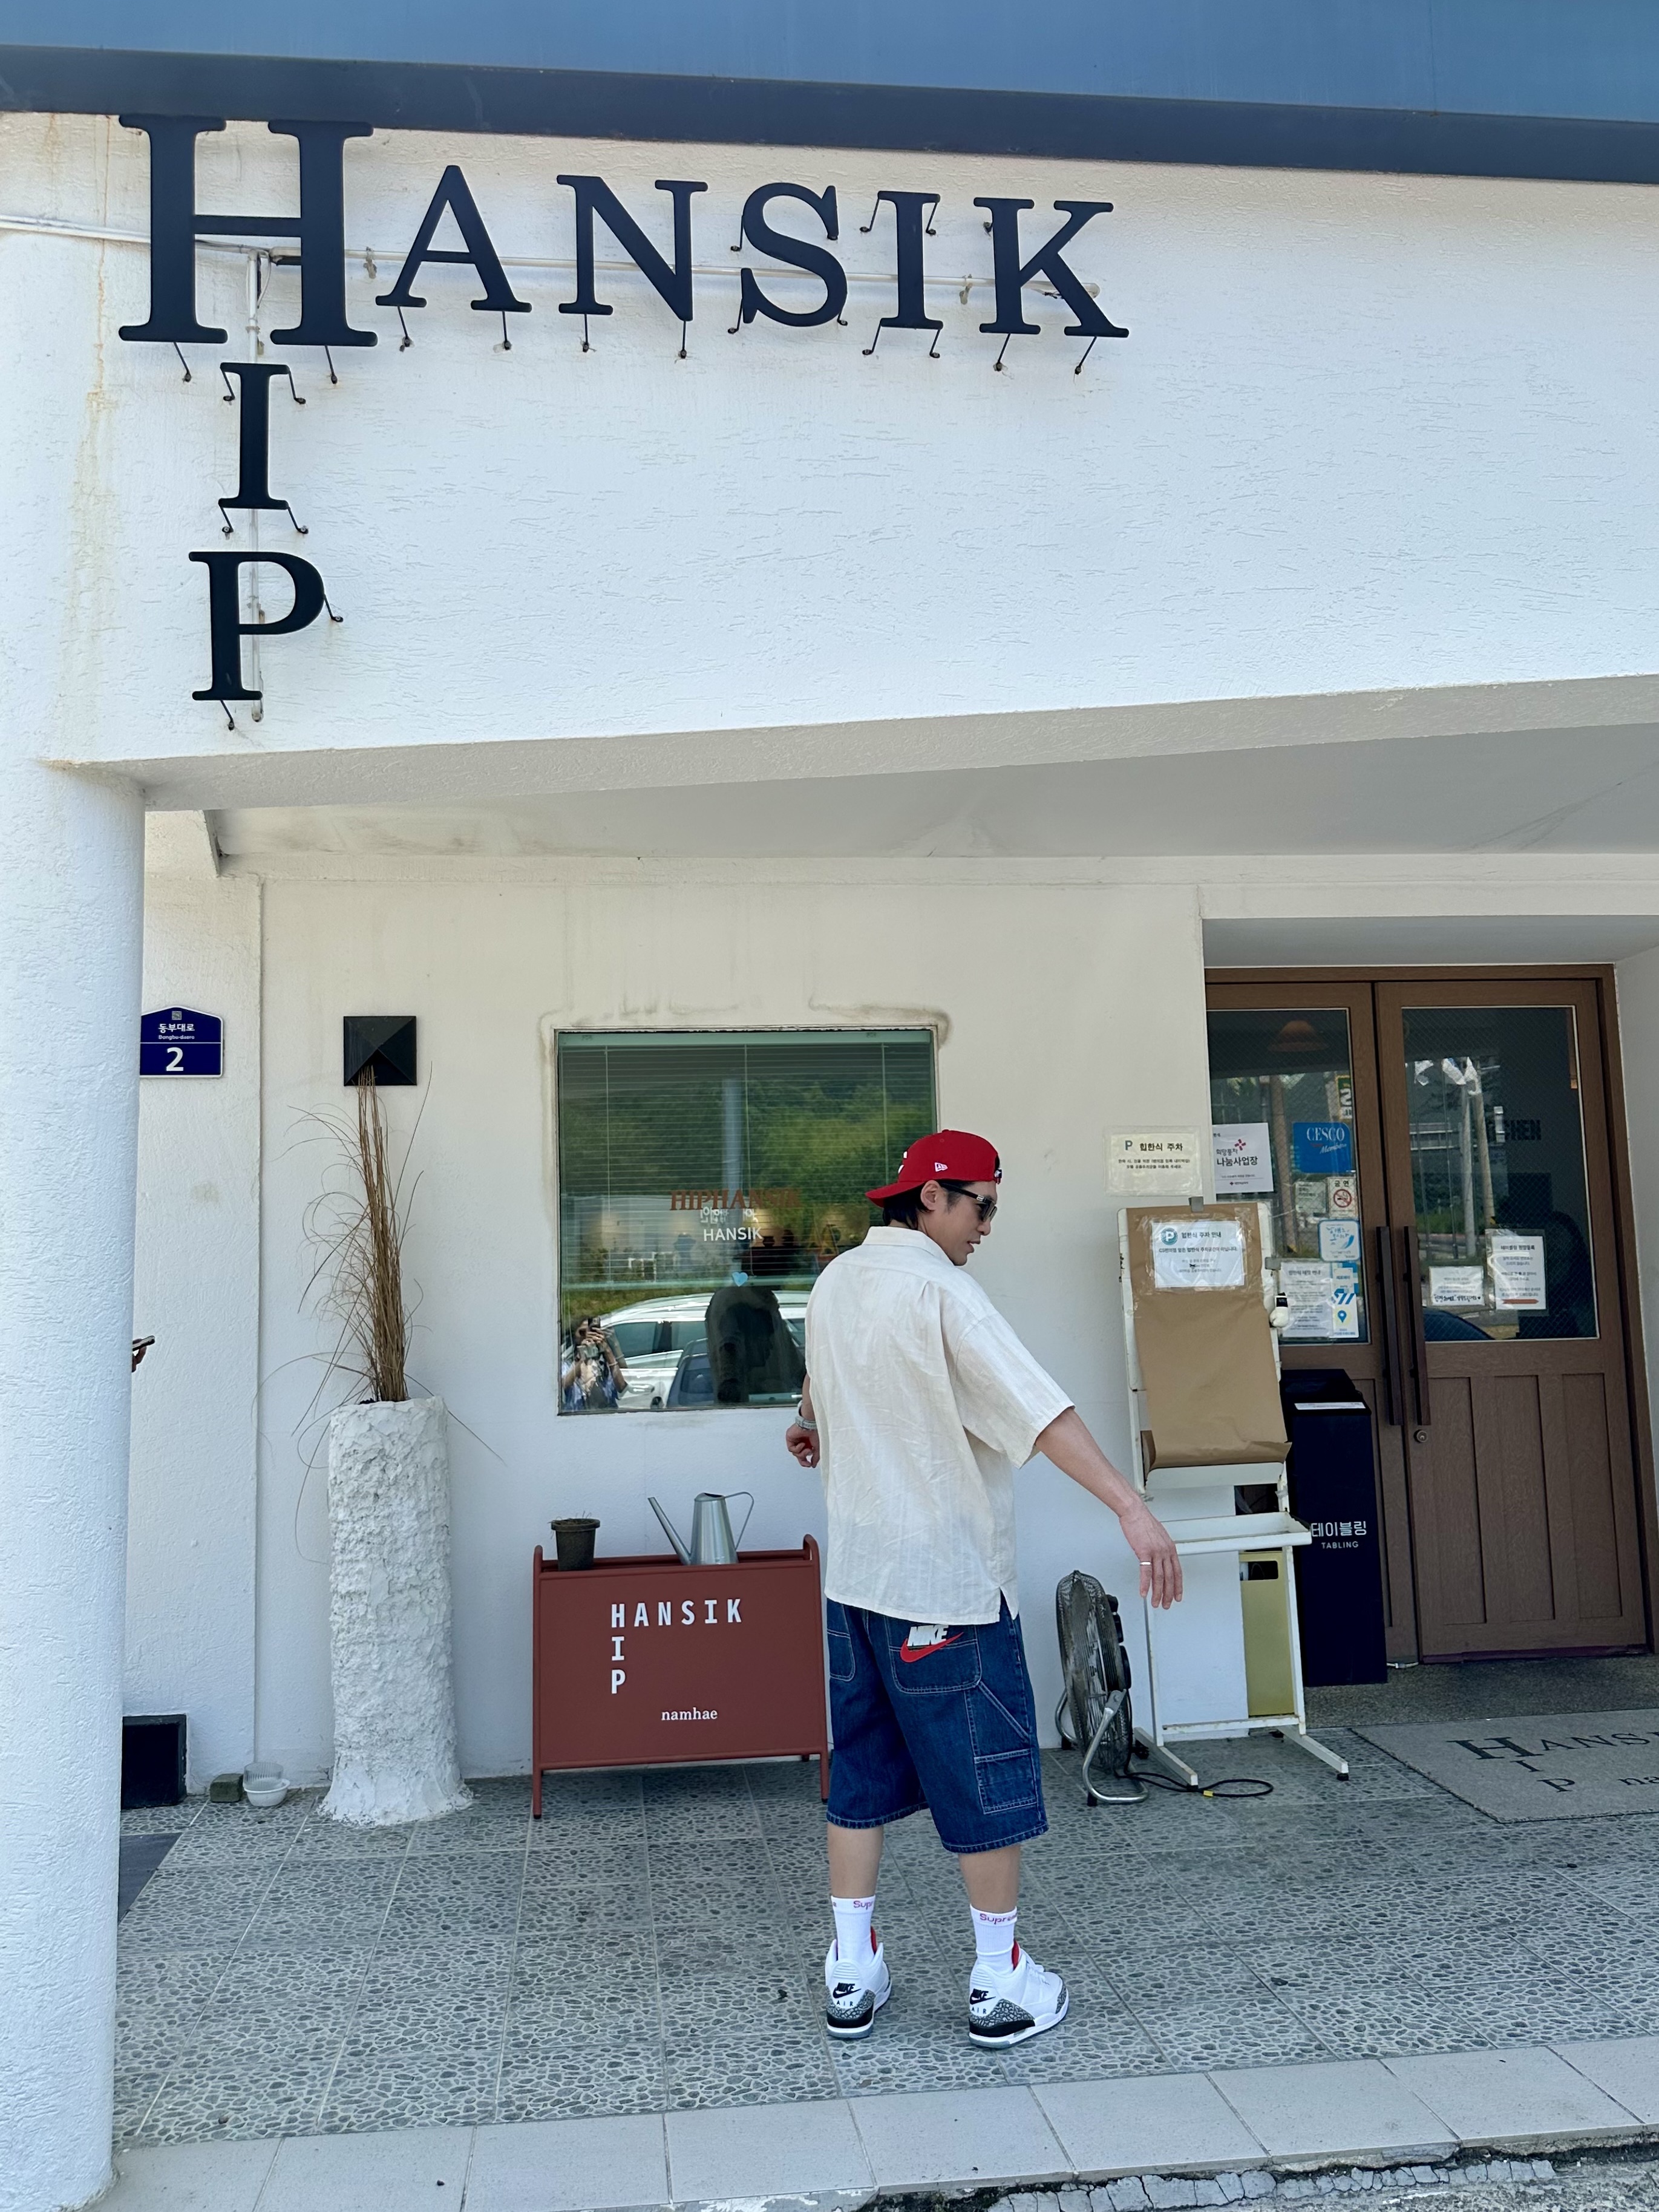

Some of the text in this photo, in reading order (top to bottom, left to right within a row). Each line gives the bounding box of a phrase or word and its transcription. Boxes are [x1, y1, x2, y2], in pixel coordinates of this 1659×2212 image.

[119, 114, 1129, 347] HANSIK
[158, 1024, 195, 1033] 동부대로
[166, 1047, 184, 1072] 2
[1306, 1127, 1345, 1141] CESCO
[1139, 1142, 1163, 1151] 힙한식
[1167, 1142, 1183, 1151] 주차
[1217, 1156, 1258, 1167] 나눔사업장
[703, 1226, 764, 1242] HANSIK
[1311, 1520, 1367, 1537] 테이블링
[611, 1598, 742, 1628] HANSIK
[907, 1624, 949, 1646] NIKE
[661, 1707, 718, 1721] namhae
